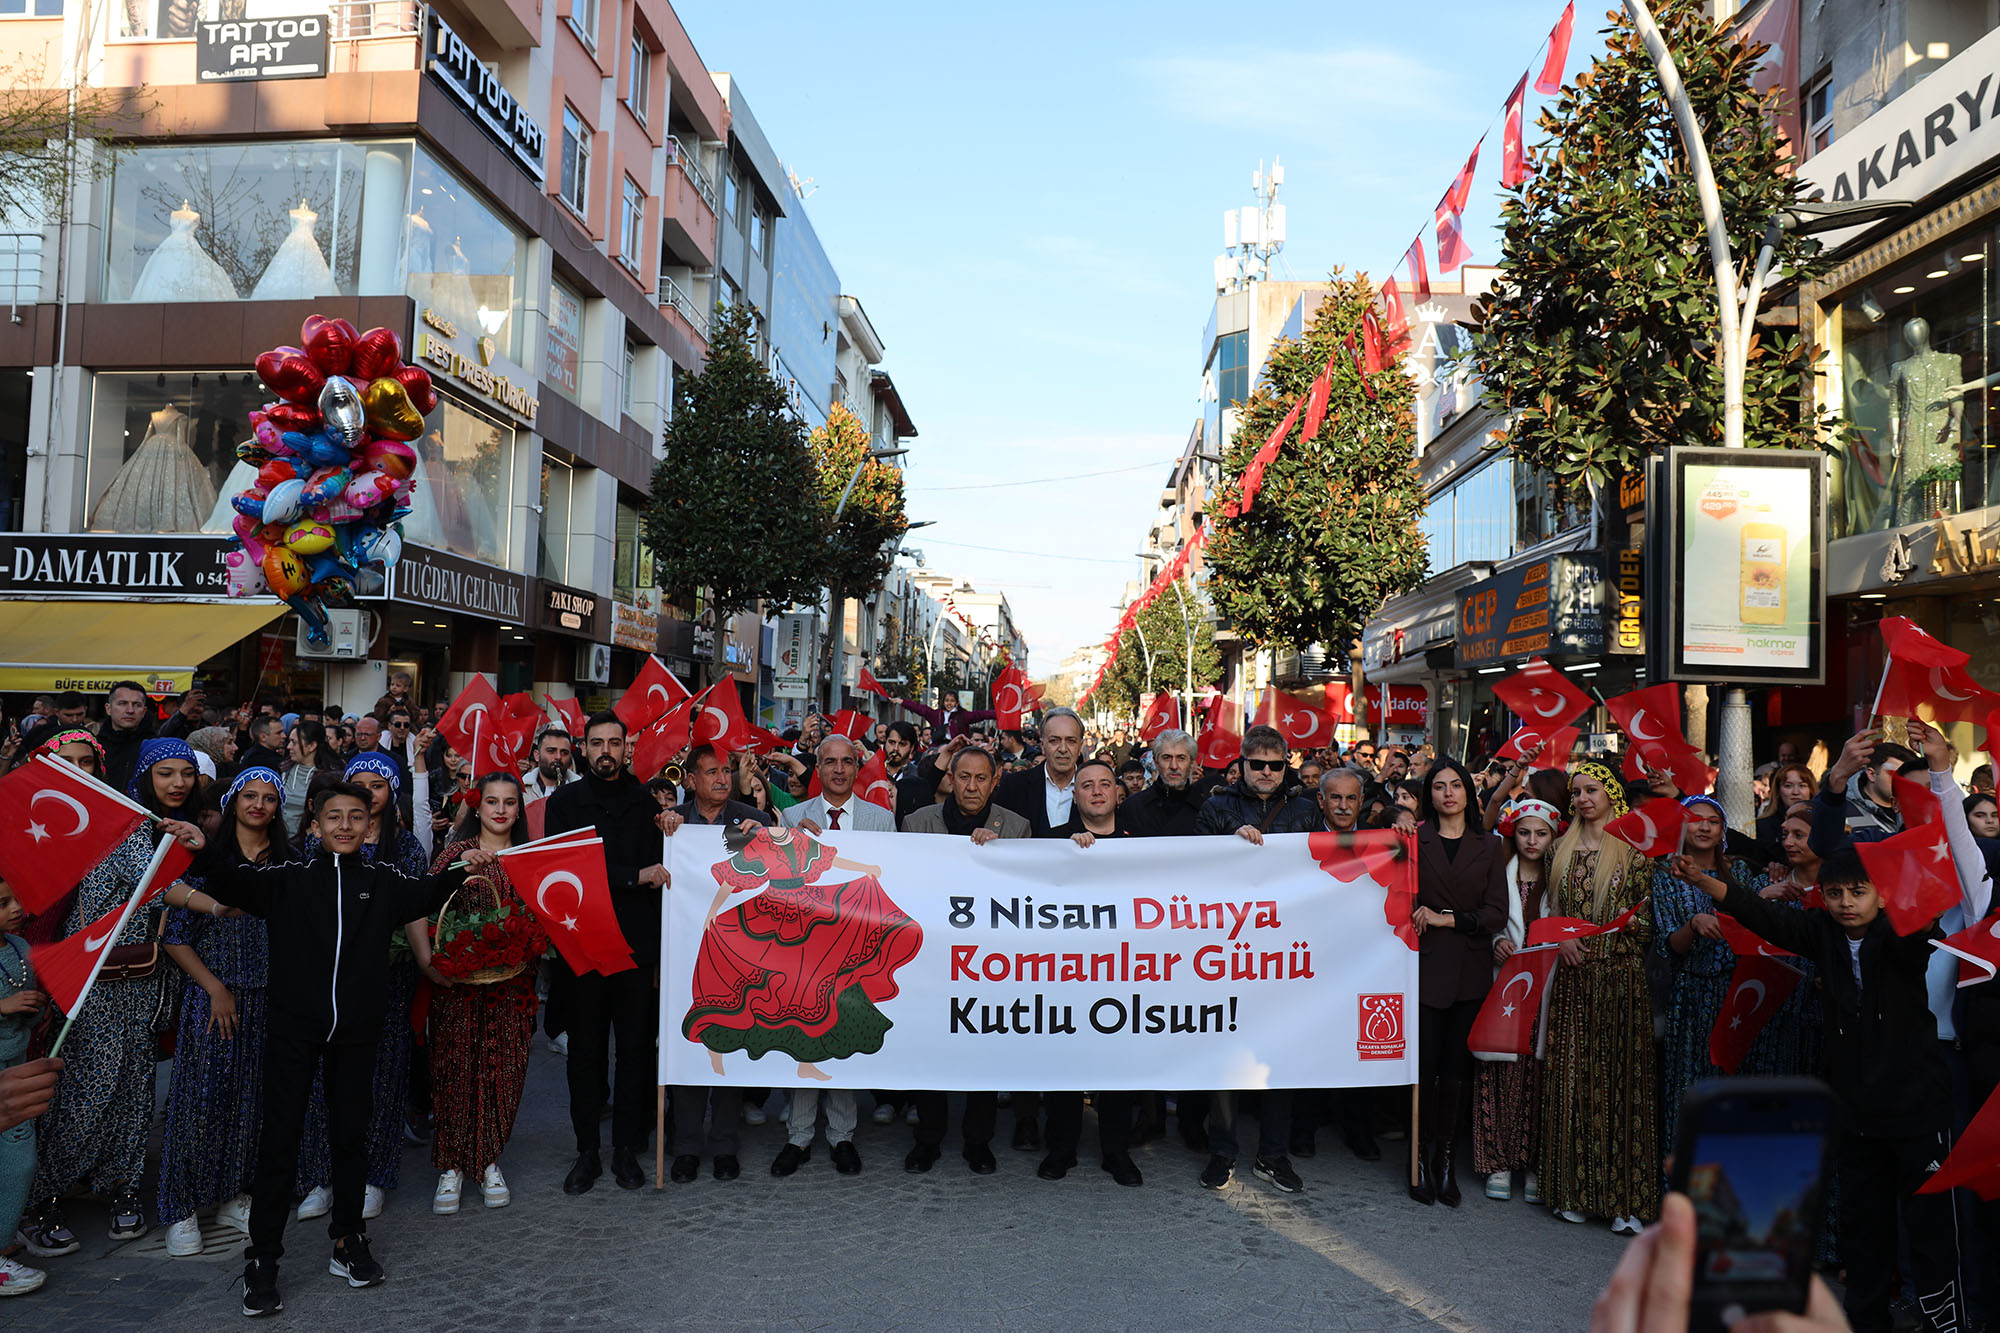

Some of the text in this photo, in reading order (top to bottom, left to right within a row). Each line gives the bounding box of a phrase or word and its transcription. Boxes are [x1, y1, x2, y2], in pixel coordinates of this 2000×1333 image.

[203, 18, 320, 45] TATTOO
[230, 41, 290, 66] ART
[437, 14, 510, 121] TATTOO
[515, 104, 548, 158] ART
[1808, 72, 2000, 201] AKARY
[421, 333, 456, 372] BEST
[456, 354, 495, 396] DRESS
[196, 572, 204, 585] 0
[401, 554, 521, 618] TUĞDEM GELİNLİK
[1565, 565, 1590, 584] SIFIR
[1592, 567, 1600, 584] &
[550, 591, 572, 610] TAKI
[572, 597, 595, 617] SHOP
[1564, 588, 1600, 614] 2.EL
[1619, 548, 1641, 648] GREYDER
[1463, 588, 1497, 637] CEP
[1462, 637, 1497, 662] MARKET
[1746, 637, 1796, 649] hakmar
[55, 677, 84, 690] BÜFE
[1401, 735, 1413, 743] EV
[1592, 739, 1608, 747] 100
[949, 894, 1282, 940] 8 Nisan Dünya
[950, 941, 1315, 983] Romanlar Günü
[949, 993, 1239, 1034] Kutlu Olsun!
